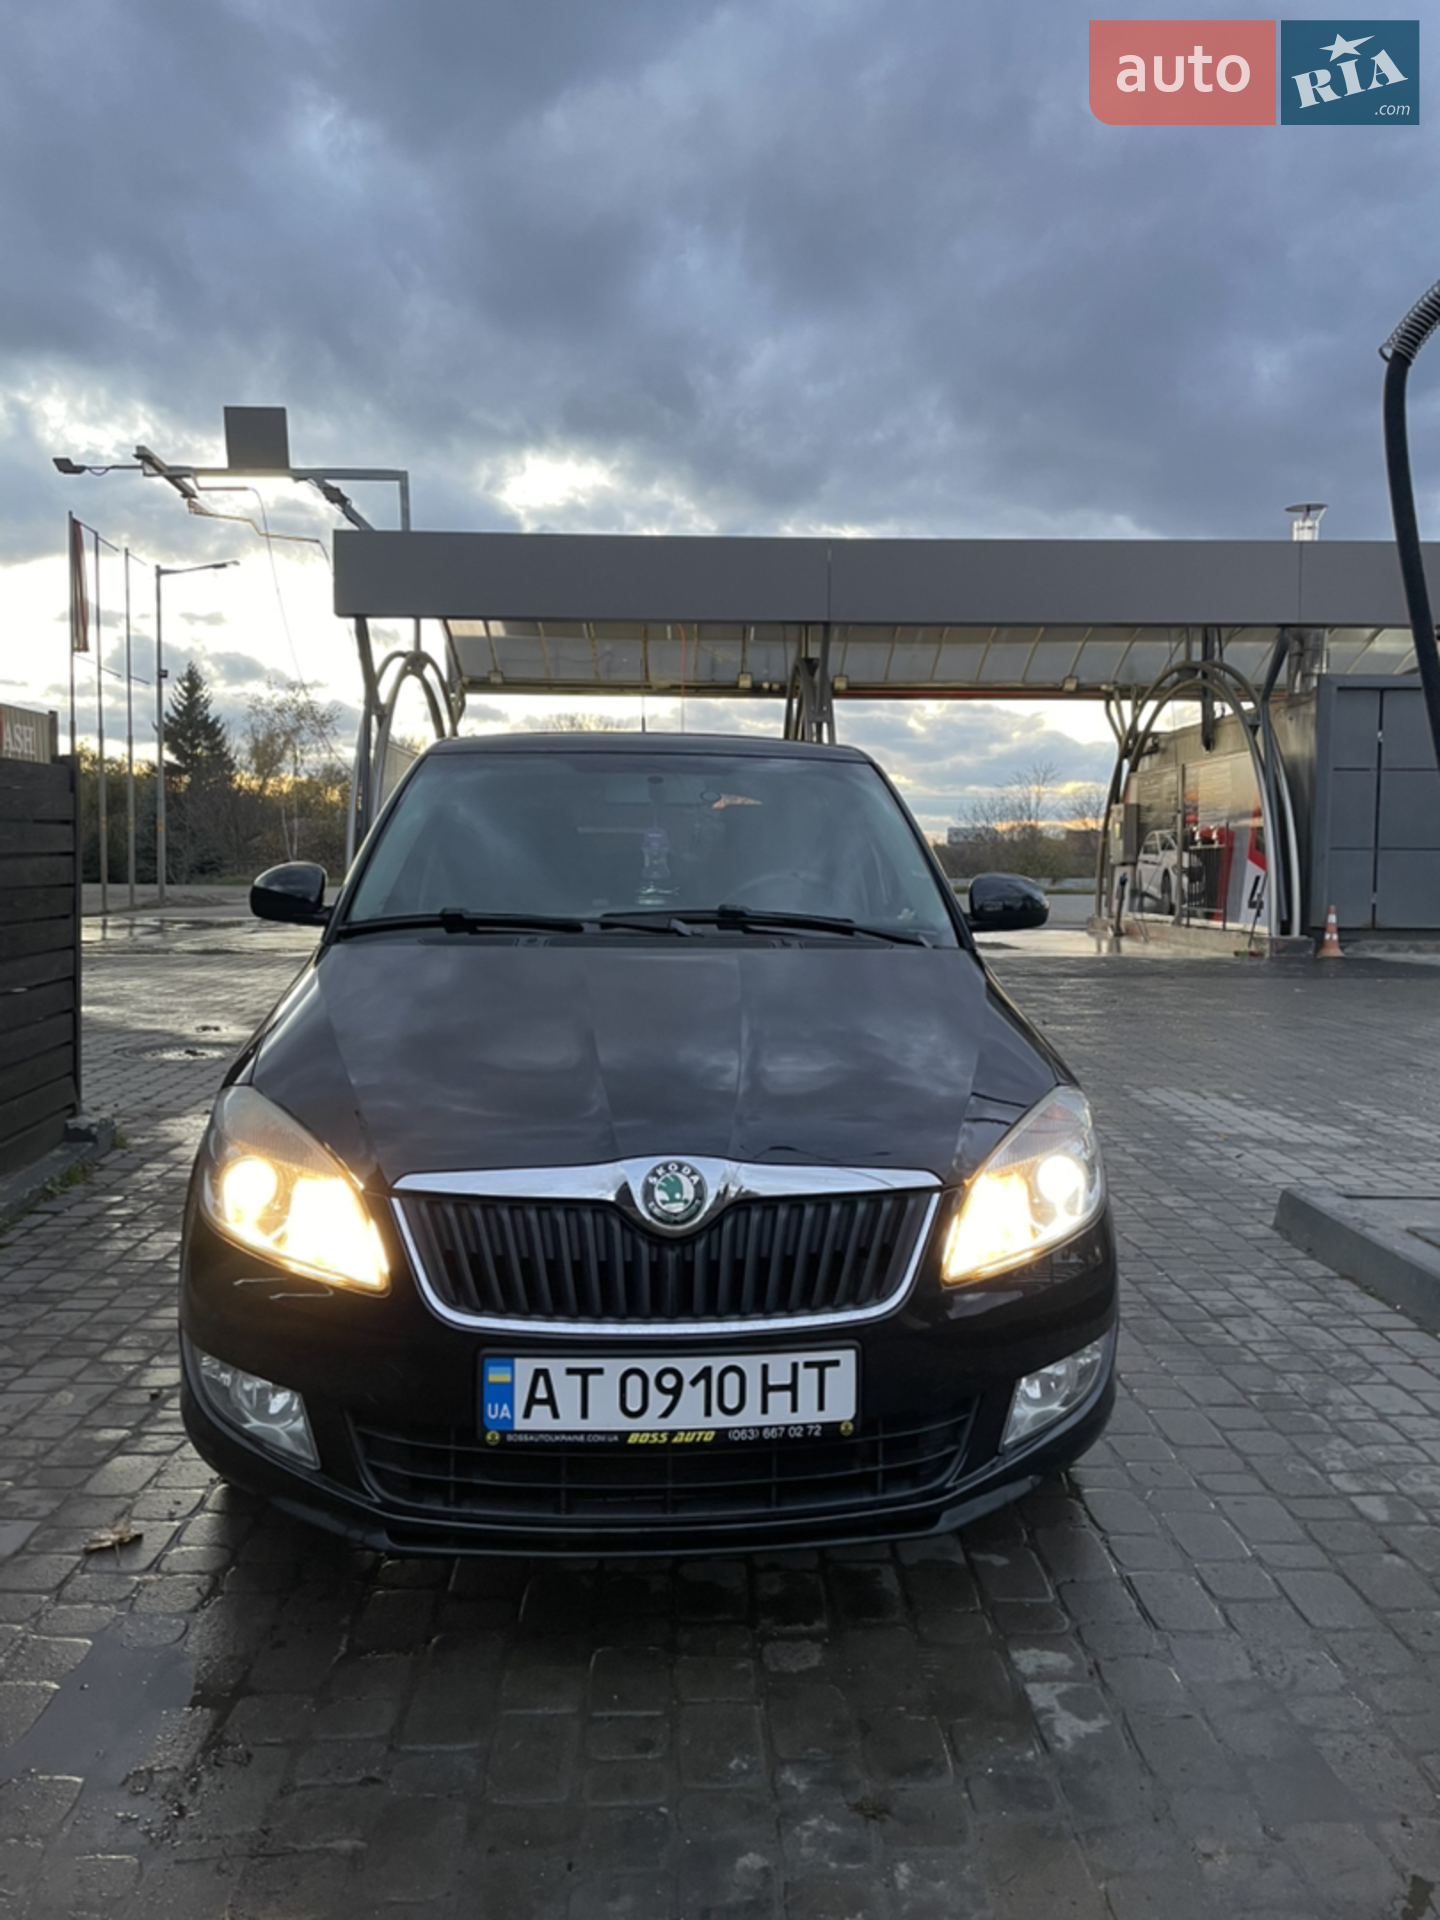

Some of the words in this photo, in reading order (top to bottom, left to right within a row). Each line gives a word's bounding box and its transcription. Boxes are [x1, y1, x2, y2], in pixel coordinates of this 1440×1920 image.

[1248, 875, 1264, 917] 4
[522, 1367, 604, 1420] AT
[619, 1364, 746, 1419] 0910
[761, 1360, 840, 1415] HT
[487, 1403, 511, 1419] UA
[627, 1432, 668, 1445] BOSS
[671, 1430, 716, 1444] AUTO
[728, 1428, 760, 1441] (063)
[788, 1426, 803, 1438] 02
[807, 1424, 822, 1436] 72
